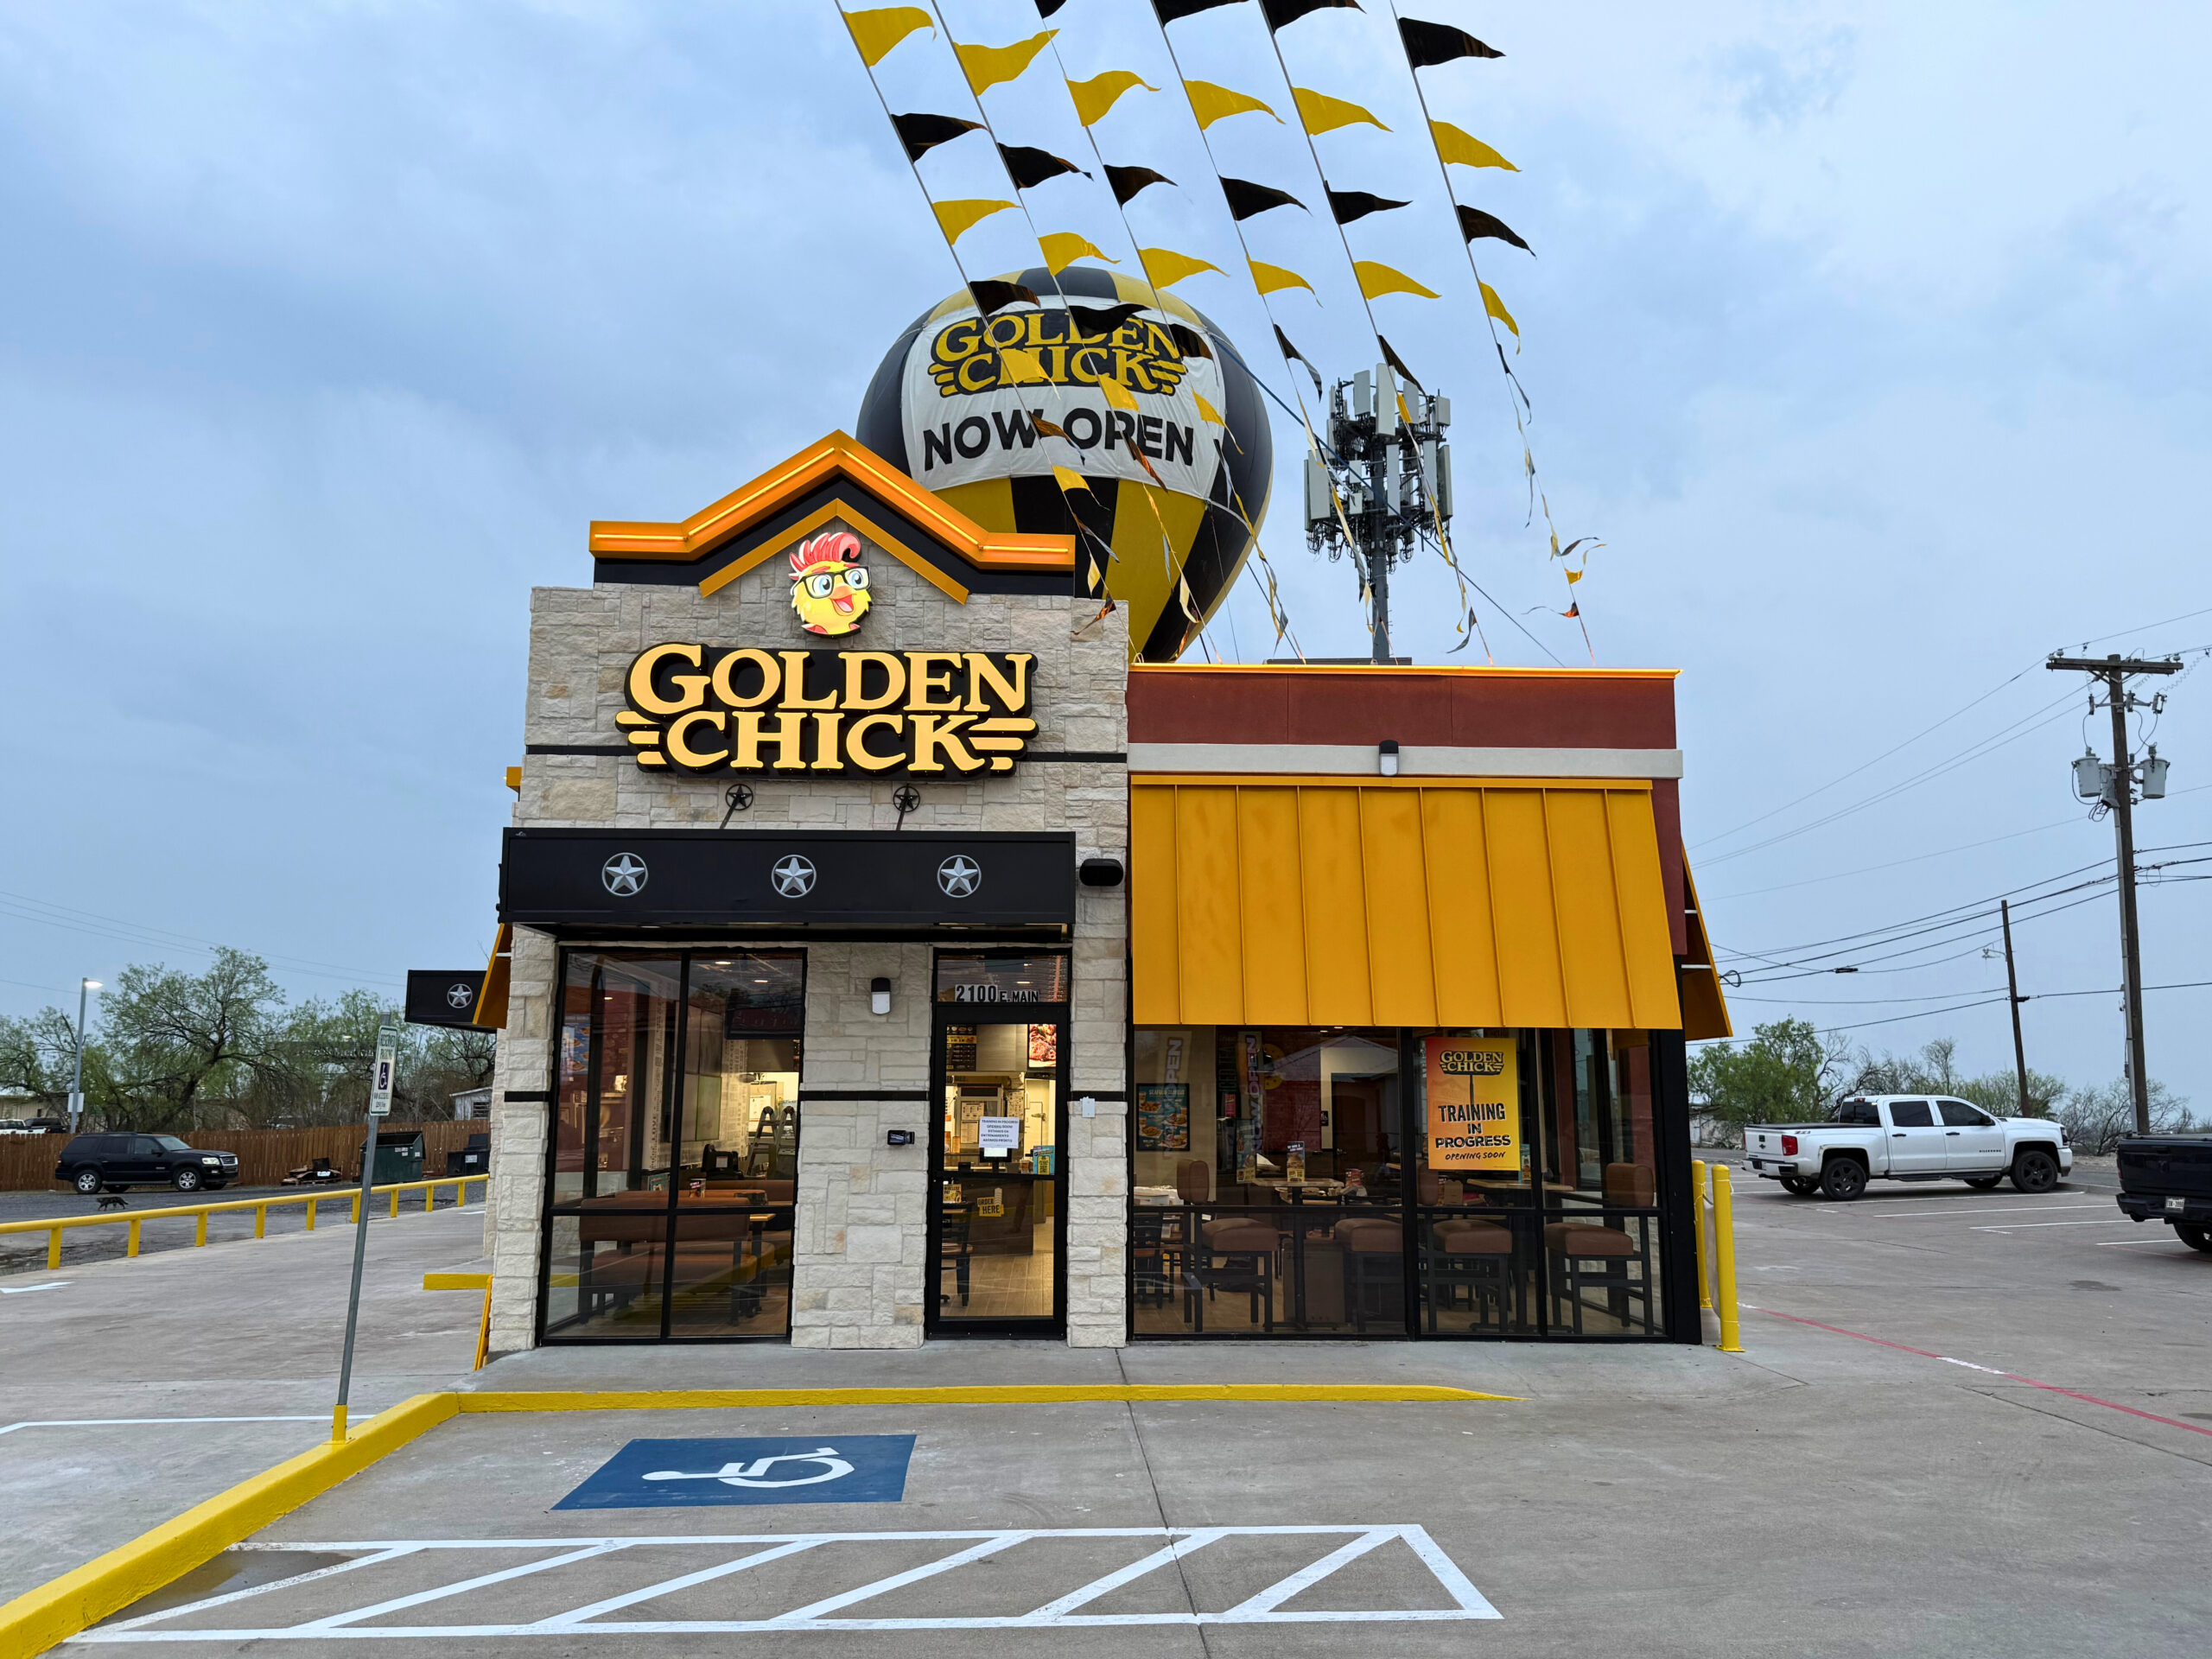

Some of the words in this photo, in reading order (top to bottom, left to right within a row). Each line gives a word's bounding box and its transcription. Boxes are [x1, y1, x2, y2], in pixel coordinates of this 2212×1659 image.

[923, 408, 1044, 471] NOW
[1063, 407, 1194, 467] OPEN
[629, 643, 1033, 715] GOLDEN
[666, 710, 986, 771] CHICK
[956, 985, 997, 1002] 2100
[1012, 990, 1039, 1002] MAIN
[1440, 1051, 1503, 1063] GOLDEN
[1446, 1062, 1494, 1072] CHICK
[1438, 1103, 1506, 1122] TRAINING
[1467, 1123, 1483, 1135] IN
[1435, 1135, 1511, 1148] PROGRESS
[1445, 1152, 1482, 1160] OPENING
[982, 1205, 1001, 1214] HERE
